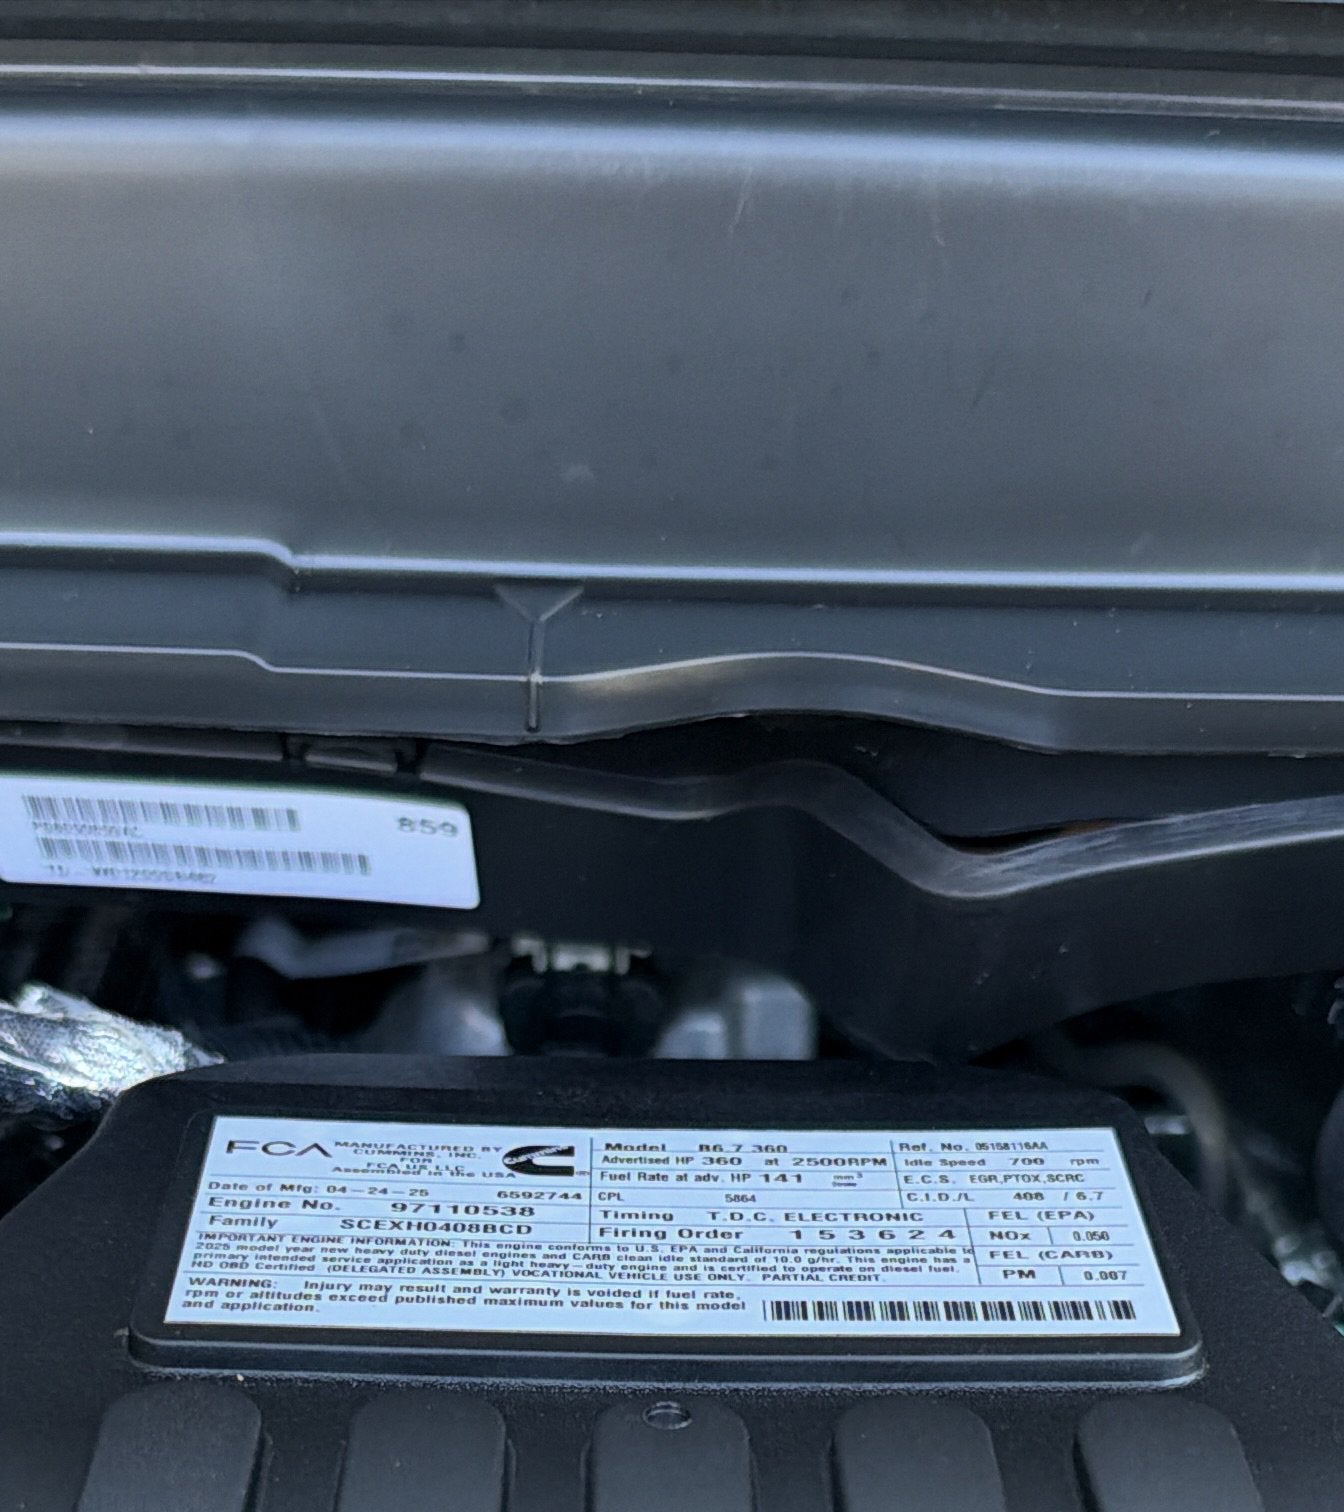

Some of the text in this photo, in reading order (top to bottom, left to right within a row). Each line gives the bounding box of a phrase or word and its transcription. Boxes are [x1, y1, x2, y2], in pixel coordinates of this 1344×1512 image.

[226, 1140, 333, 1158] FCA
[335, 1141, 474, 1152] MANUFACTURED
[604, 1143, 666, 1152] Model
[752, 1144, 788, 1153] 360
[899, 1143, 934, 1151] Ref.
[940, 1143, 970, 1151] No.
[406, 1163, 429, 1171] US
[437, 1164, 464, 1172] LLC
[602, 1155, 888, 1167] Advertised HP 360 at 2500RPM
[905, 1157, 1099, 1167] Idle Speed 700 rpm
[332, 1166, 421, 1176] Assembled
[482, 1171, 516, 1179] USA
[600, 1171, 631, 1182] Fuel
[637, 1172, 669, 1182] Rate
[675, 1173, 688, 1182] at
[694, 1173, 725, 1183] adv.
[731, 1173, 751, 1182] HP
[759, 1173, 803, 1183] 141
[903, 1175, 956, 1185] E.C.S.
[208, 1181, 249, 1191] Date
[256, 1183, 273, 1192] of
[280, 1183, 318, 1195] Mfg:
[496, 1190, 583, 1200] 6592744
[598, 1192, 625, 1201] CPL
[208, 1197, 536, 1217] Engine No. 97110538
[208, 1215, 279, 1229] Family
[599, 1209, 925, 1222] Timing T.D.C. ELECTRONIC
[988, 1210, 1095, 1222] FEL (EPA)
[599, 1227, 667, 1240] Firing
[677, 1228, 744, 1240] Order
[989, 1230, 1032, 1241] NOx
[198, 1233, 284, 1243] IMPORTANT
[292, 1235, 344, 1244] ENGINE
[350, 1236, 455, 1247] INFORMATION:
[463, 1239, 491, 1249] This
[497, 1242, 543, 1251] engine
[548, 1243, 611, 1252] conforms
[617, 1244, 630, 1252] to
[671, 1245, 698, 1253] EPA
[704, 1246, 727, 1254] and
[733, 1246, 799, 1254] California
[805, 1247, 881, 1256] regulations
[886, 1247, 957, 1256] applicable
[195, 1242, 231, 1250] 2025
[285, 1245, 315, 1254] year
[355, 1247, 394, 1256] heavy
[400, 1248, 430, 1257] duty
[435, 1249, 476, 1258] diesel
[482, 1250, 537, 1260] engines
[542, 1251, 567, 1259] and
[572, 1253, 611, 1261] CARB
[617, 1254, 653, 1262] clean
[659, 1254, 684, 1263] idle
[690, 1255, 748, 1264] standard
[754, 1255, 767, 1263] of
[773, 1256, 802, 1264] 10.0
[848, 1256, 876, 1264] This
[881, 1257, 928, 1265] engine
[933, 1256, 957, 1264] has
[989, 1249, 1114, 1261] FEL (CARB)
[193, 1252, 249, 1261] primary
[254, 1253, 315, 1262] intended
[322, 1255, 371, 1264] service
[377, 1257, 453, 1266] application
[493, 1259, 524, 1269] light
[620, 1264, 667, 1272] engine
[673, 1264, 698, 1272] and
[704, 1264, 715, 1272] is
[721, 1264, 777, 1273] certified
[783, 1265, 796, 1273] to
[801, 1266, 853, 1274] operate
[881, 1265, 923, 1273] diesel
[219, 1262, 249, 1270] OBD
[255, 1262, 315, 1272] Certified
[327, 1264, 416, 1274] (DELEGATED
[422, 1267, 505, 1278] ASSEMBLY)
[512, 1268, 603, 1279] VOCATIONAL
[608, 1271, 668, 1281] VEHICLE
[674, 1273, 704, 1281] USE
[708, 1273, 751, 1282] ONLY.
[762, 1274, 824, 1282] PARTIAL
[829, 1274, 886, 1282] CREDIT.
[1002, 1269, 1036, 1279] PM
[189, 1277, 278, 1289] WARNING:
[304, 1280, 353, 1292] Injury
[359, 1283, 393, 1293] may
[399, 1284, 446, 1294] result
[453, 1285, 482, 1294] and
[489, 1286, 561, 1298] warranty
[567, 1287, 581, 1297] is
[587, 1288, 642, 1298] voided
[649, 1289, 659, 1298] if
[666, 1290, 696, 1299] fuel
[182, 1300, 320, 1313] and application.
[185, 1289, 746, 1311] rpm or altitudes exceed published maximum values for this model
